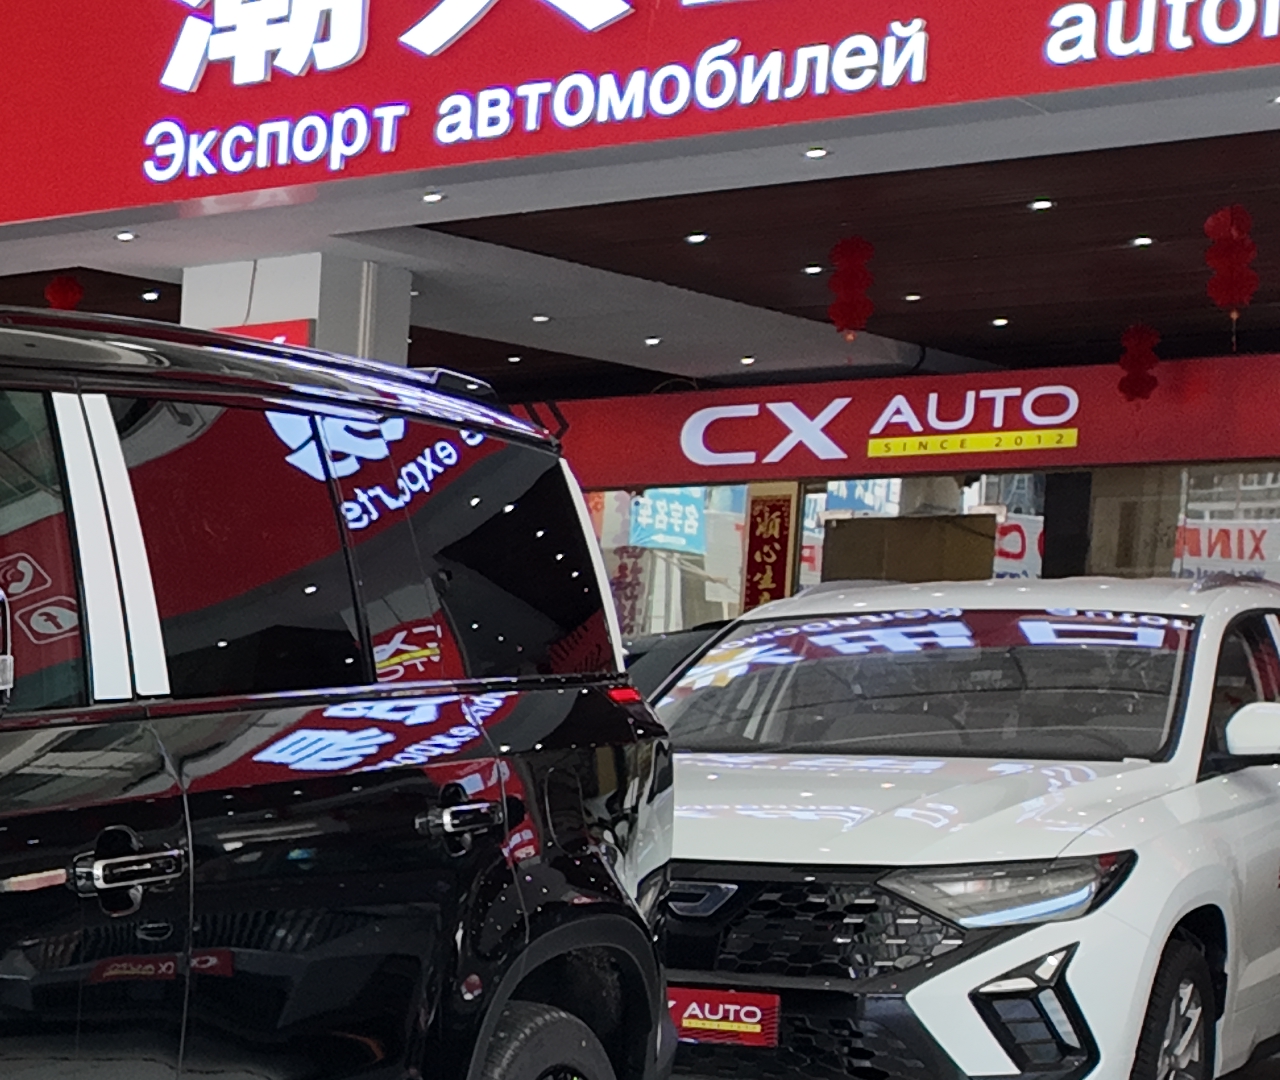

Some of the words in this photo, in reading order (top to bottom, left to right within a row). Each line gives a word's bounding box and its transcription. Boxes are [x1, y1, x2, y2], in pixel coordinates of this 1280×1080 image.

[1045, 0, 1280, 65] auto
[143, 106, 410, 183] Экспорт
[434, 18, 930, 145] автомобилей
[680, 397, 852, 466] CX
[869, 386, 1079, 435] AUTO
[884, 439, 968, 454] SINCE
[994, 433, 1064, 447] 2012
[683, 1002, 762, 1023] AUTO
